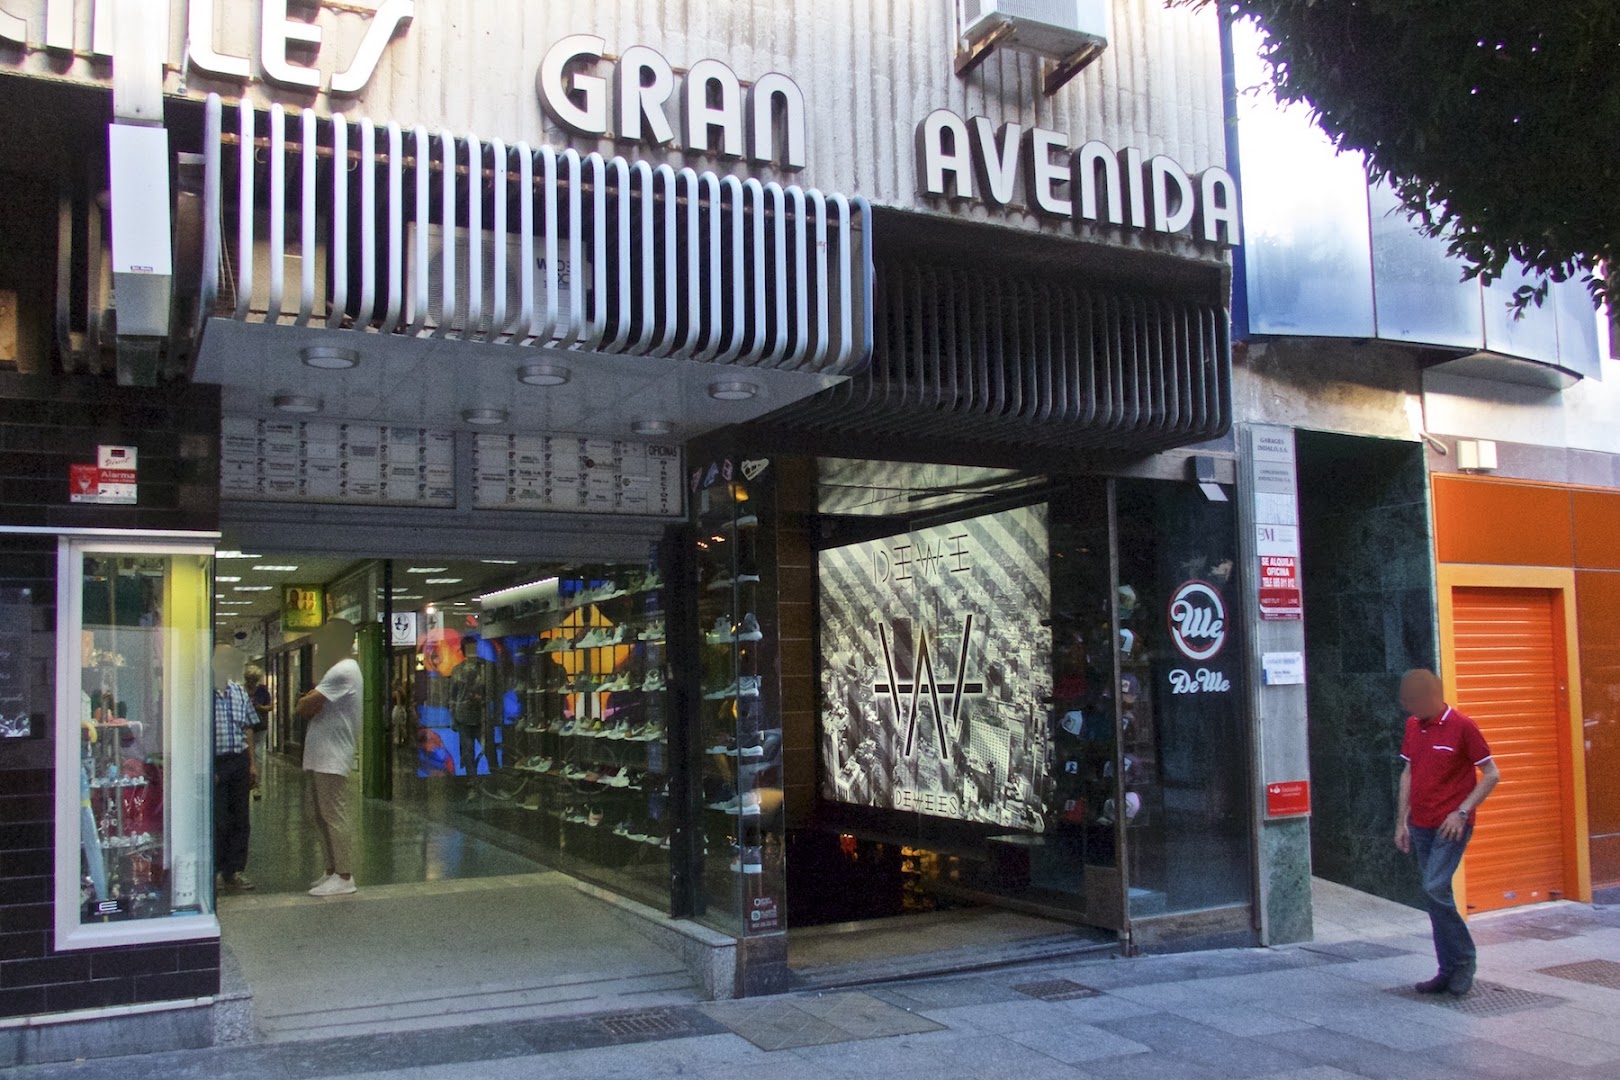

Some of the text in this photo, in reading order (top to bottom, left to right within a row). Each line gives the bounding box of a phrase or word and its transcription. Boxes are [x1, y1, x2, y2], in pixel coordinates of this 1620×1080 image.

[541, 34, 805, 169] GRAN
[916, 108, 1240, 247] AVENIDA
[648, 445, 677, 457] OFICINAS
[101, 471, 135, 479] Alarma
[1261, 557, 1294, 567] SE ALQUILA
[1267, 567, 1290, 576] OFICINA
